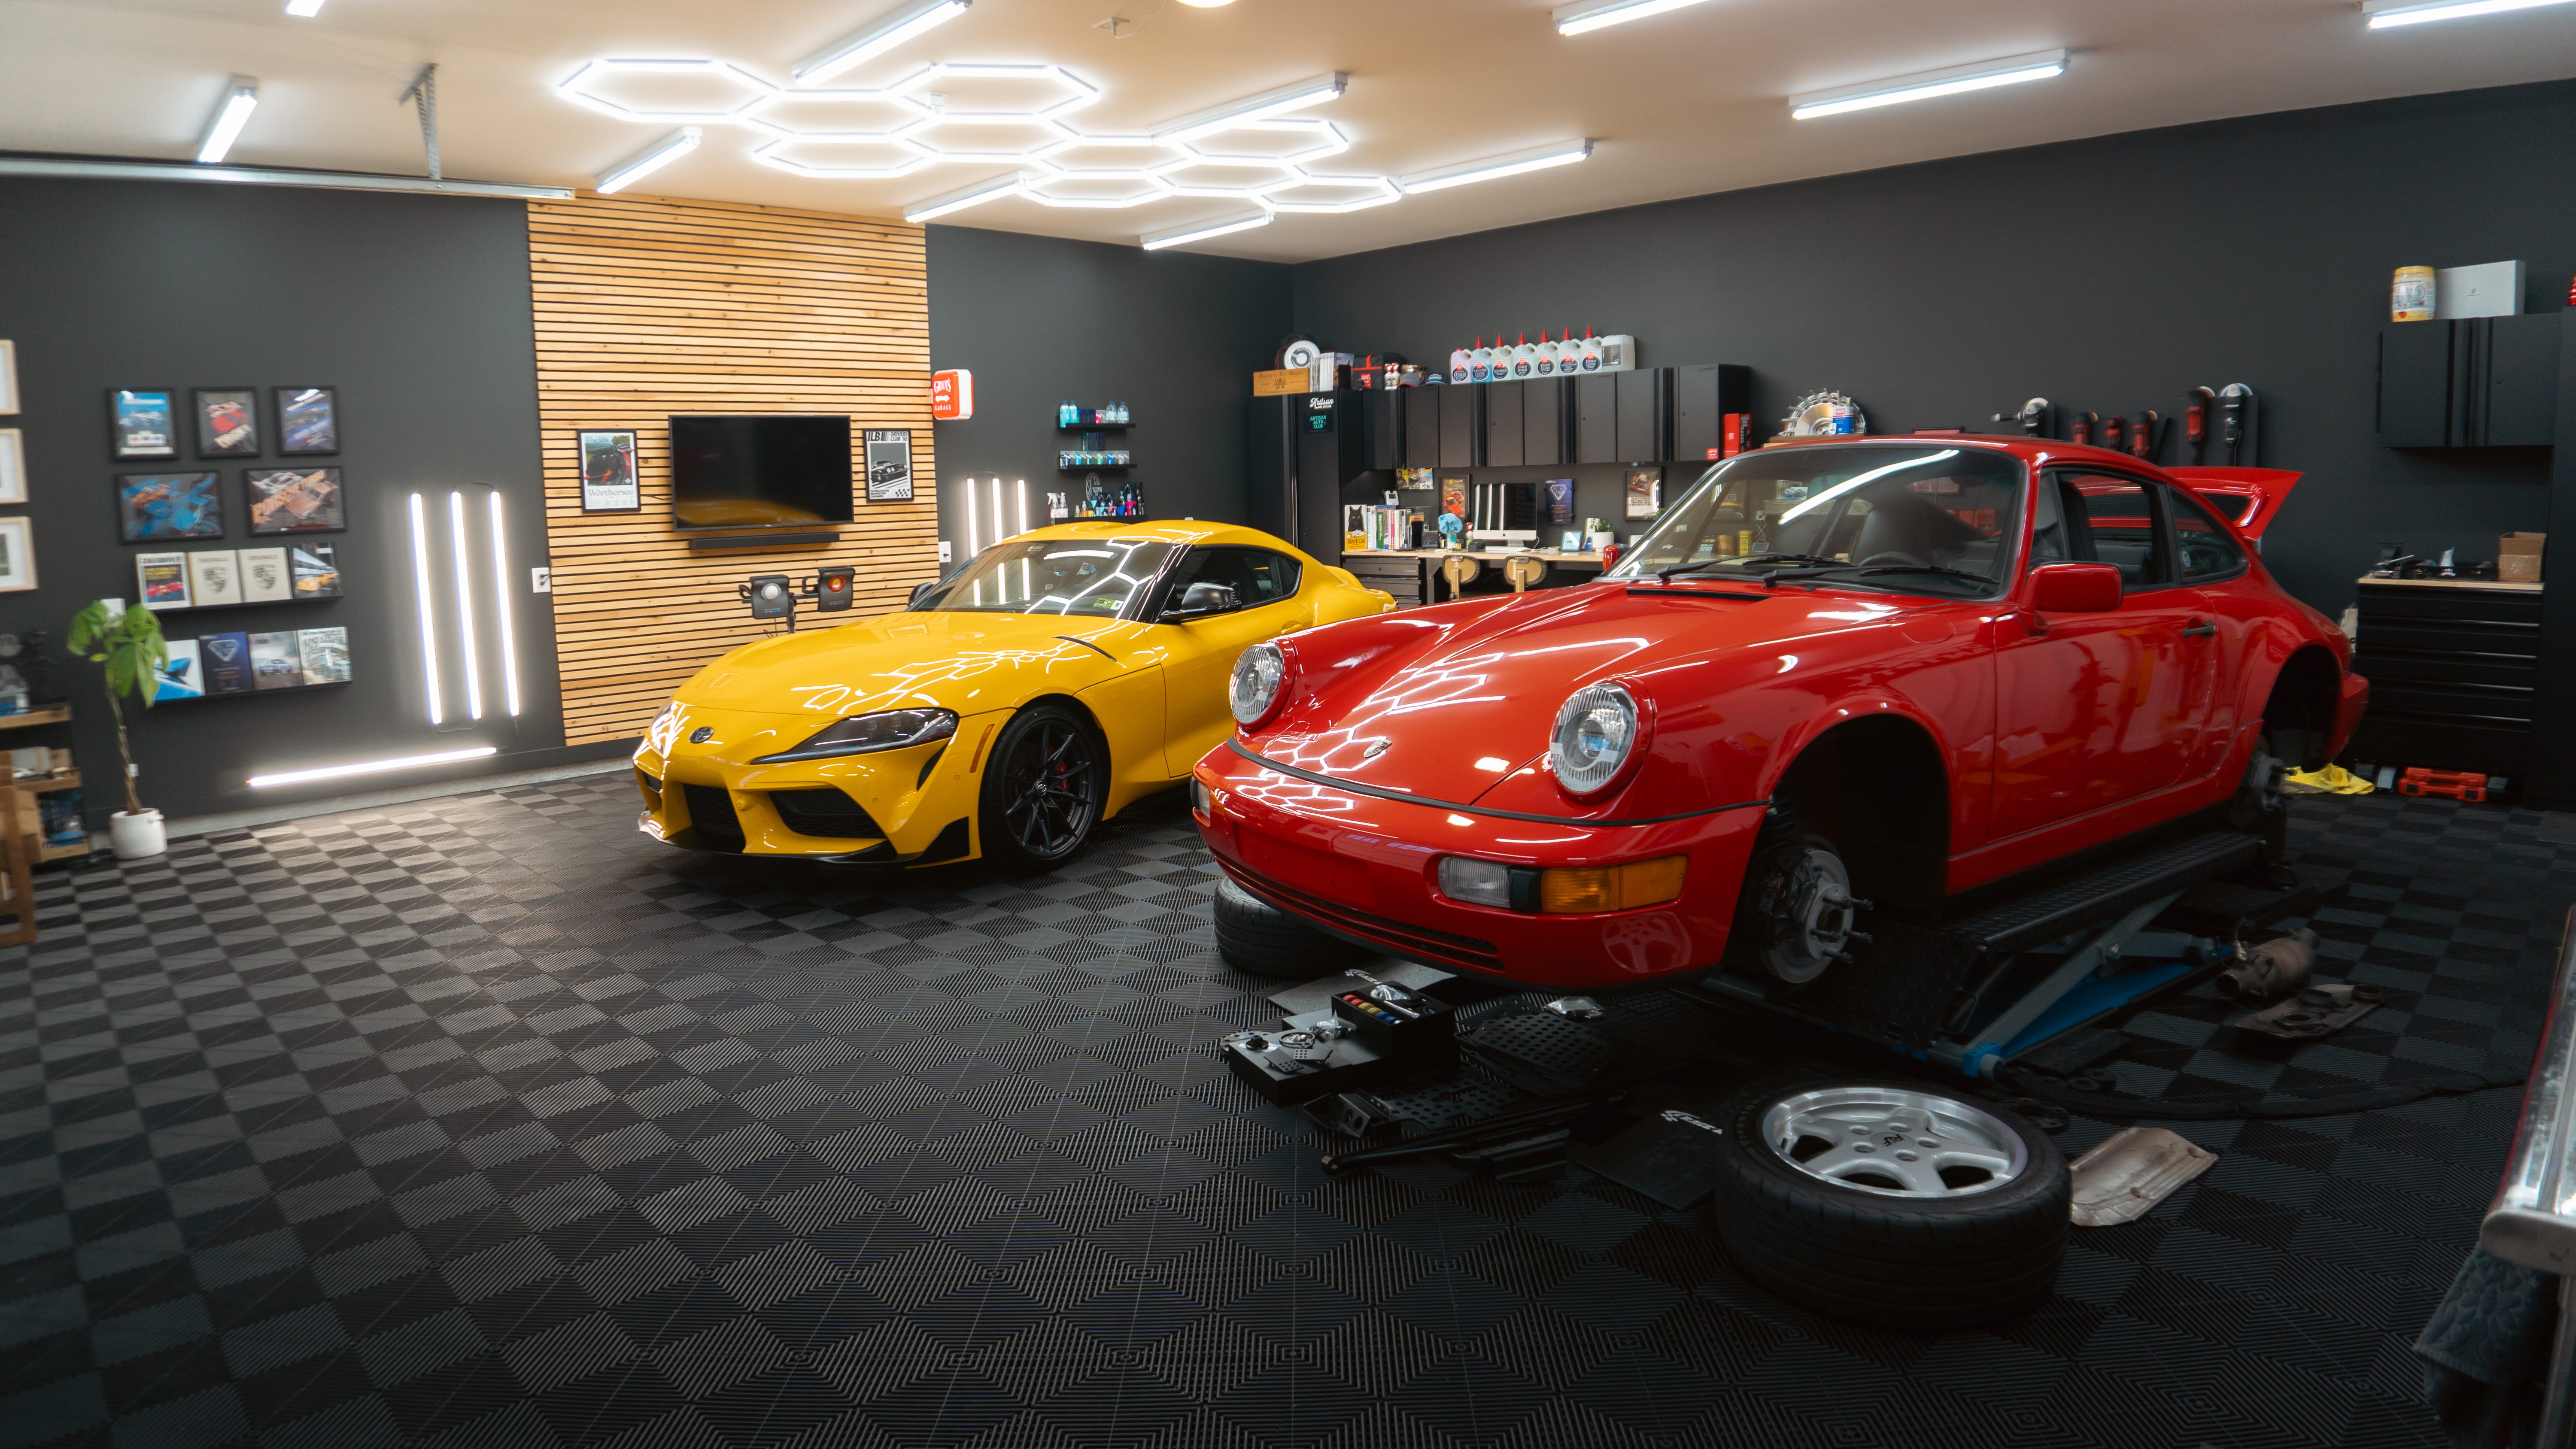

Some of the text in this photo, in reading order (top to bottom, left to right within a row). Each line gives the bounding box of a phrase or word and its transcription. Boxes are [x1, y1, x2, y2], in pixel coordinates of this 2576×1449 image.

[934, 377, 951, 393] GRIOT'S
[1309, 397, 1334, 409] Artisan
[1883, 1134, 1905, 1147] RUF
